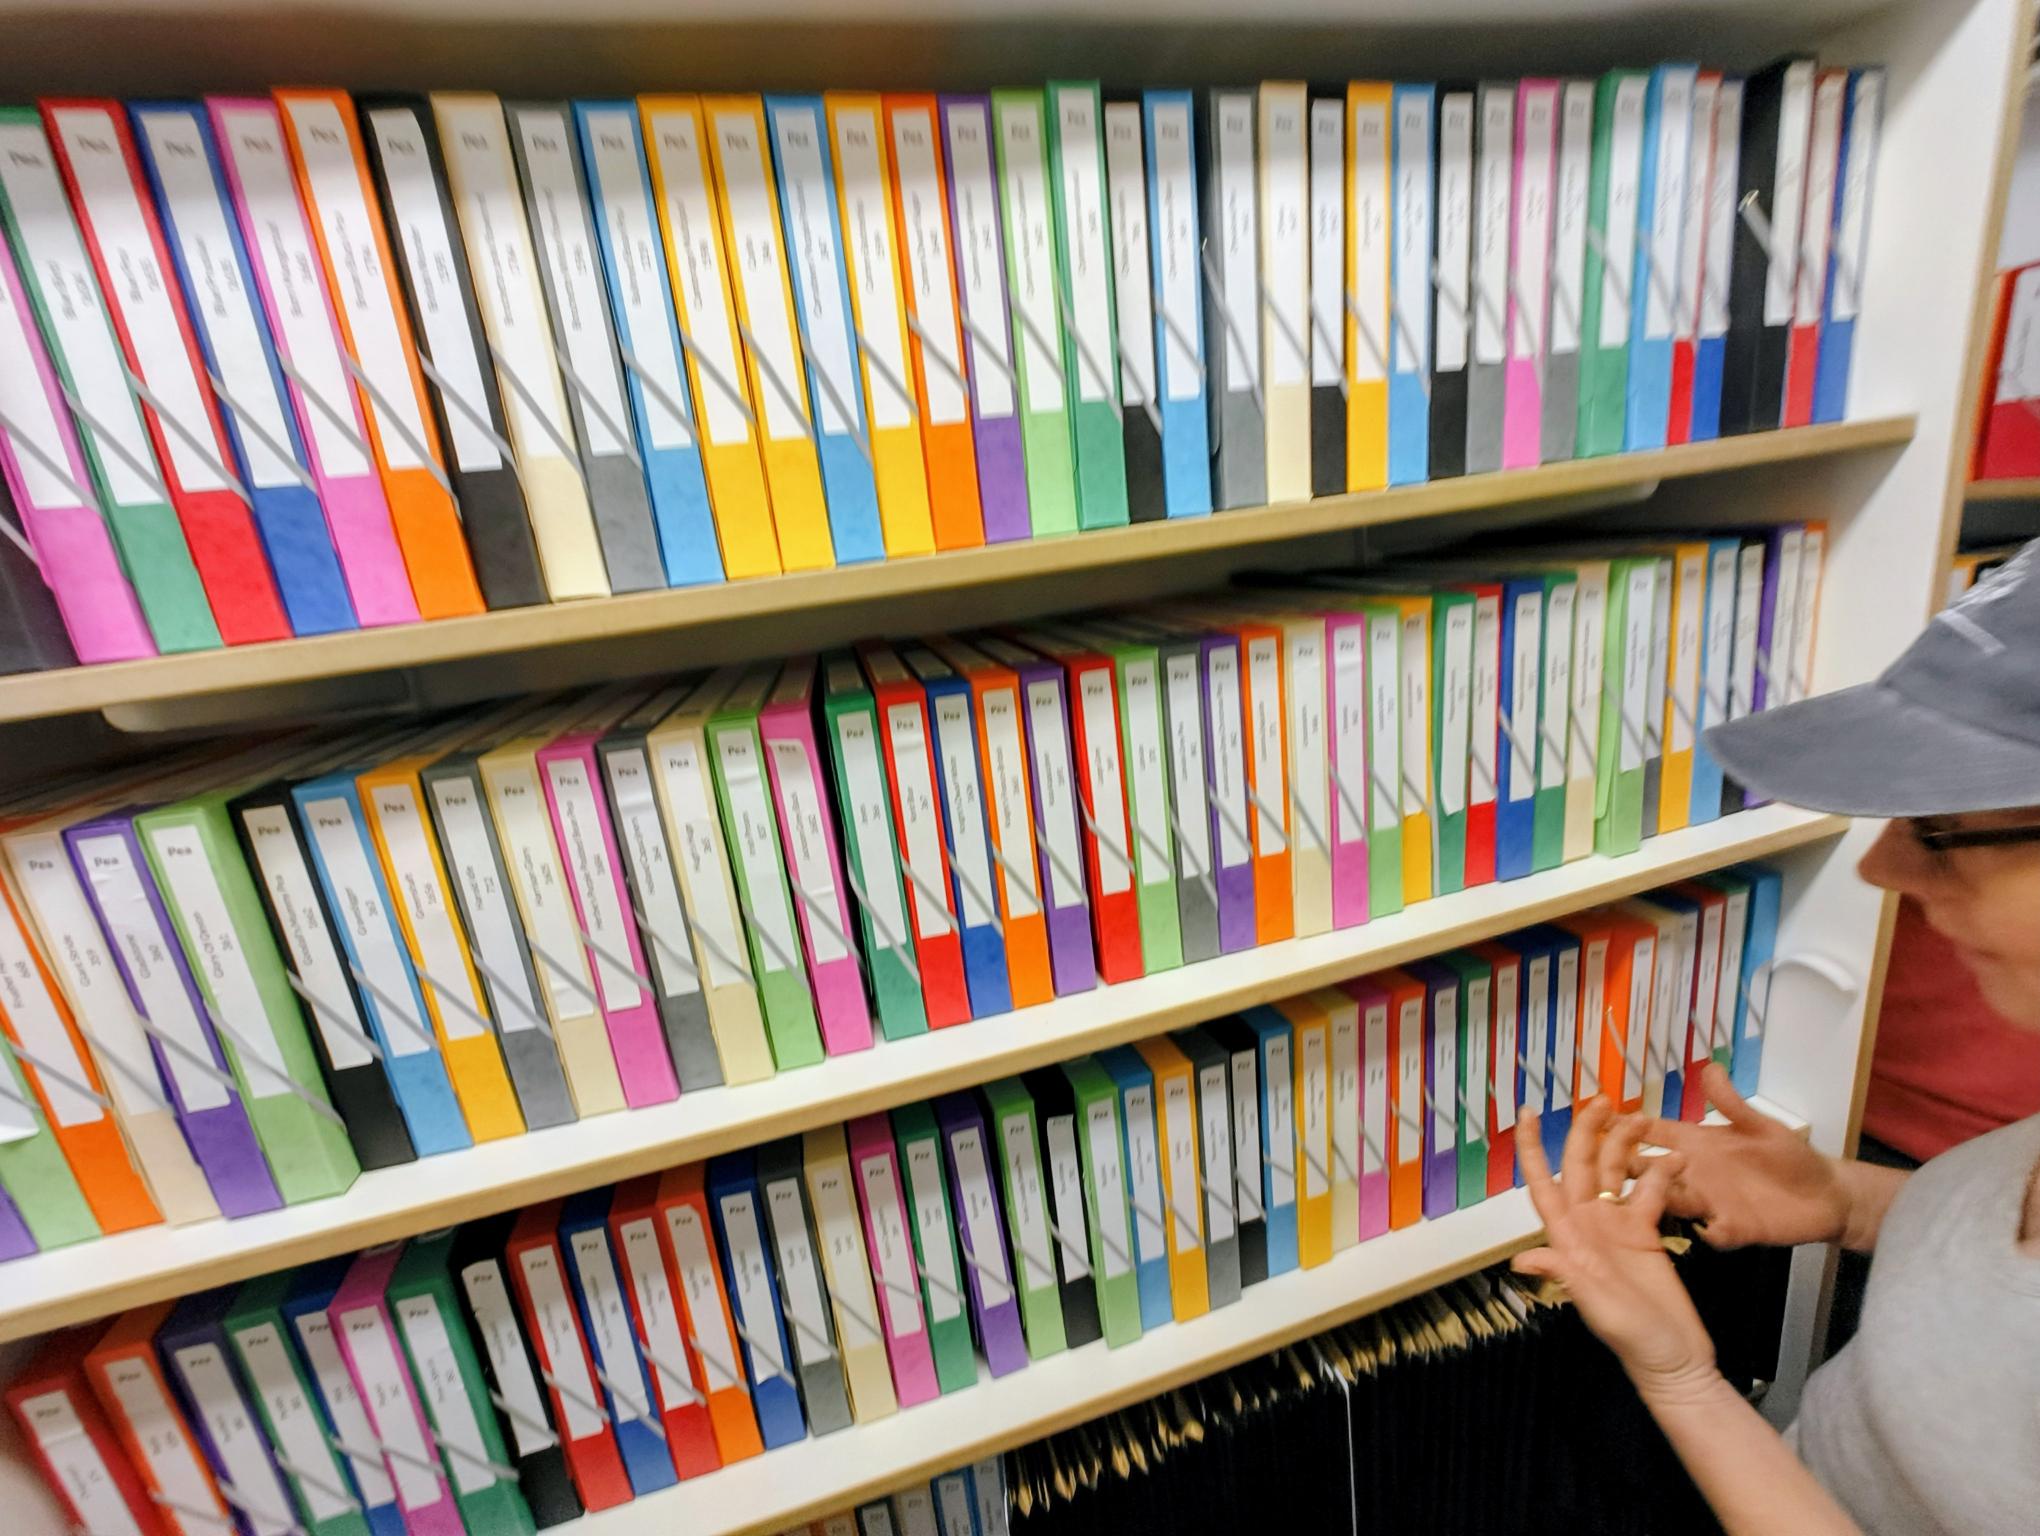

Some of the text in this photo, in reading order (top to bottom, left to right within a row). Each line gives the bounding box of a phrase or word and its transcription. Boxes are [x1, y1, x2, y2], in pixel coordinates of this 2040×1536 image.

[728, 745, 746, 755] Pea
[669, 759, 689, 768] Pea
[618, 768, 637, 777] Pea
[559, 776, 579, 786] Pea
[504, 786, 524, 796] Pea
[445, 797, 466, 805] Pea
[384, 804, 405, 812] Pea
[318, 818, 342, 827] Pea
[257, 826, 280, 836] Pea
[168, 847, 192, 856] Pea
[28, 860, 53, 870] Pea
[94, 857, 119, 867] Pea
